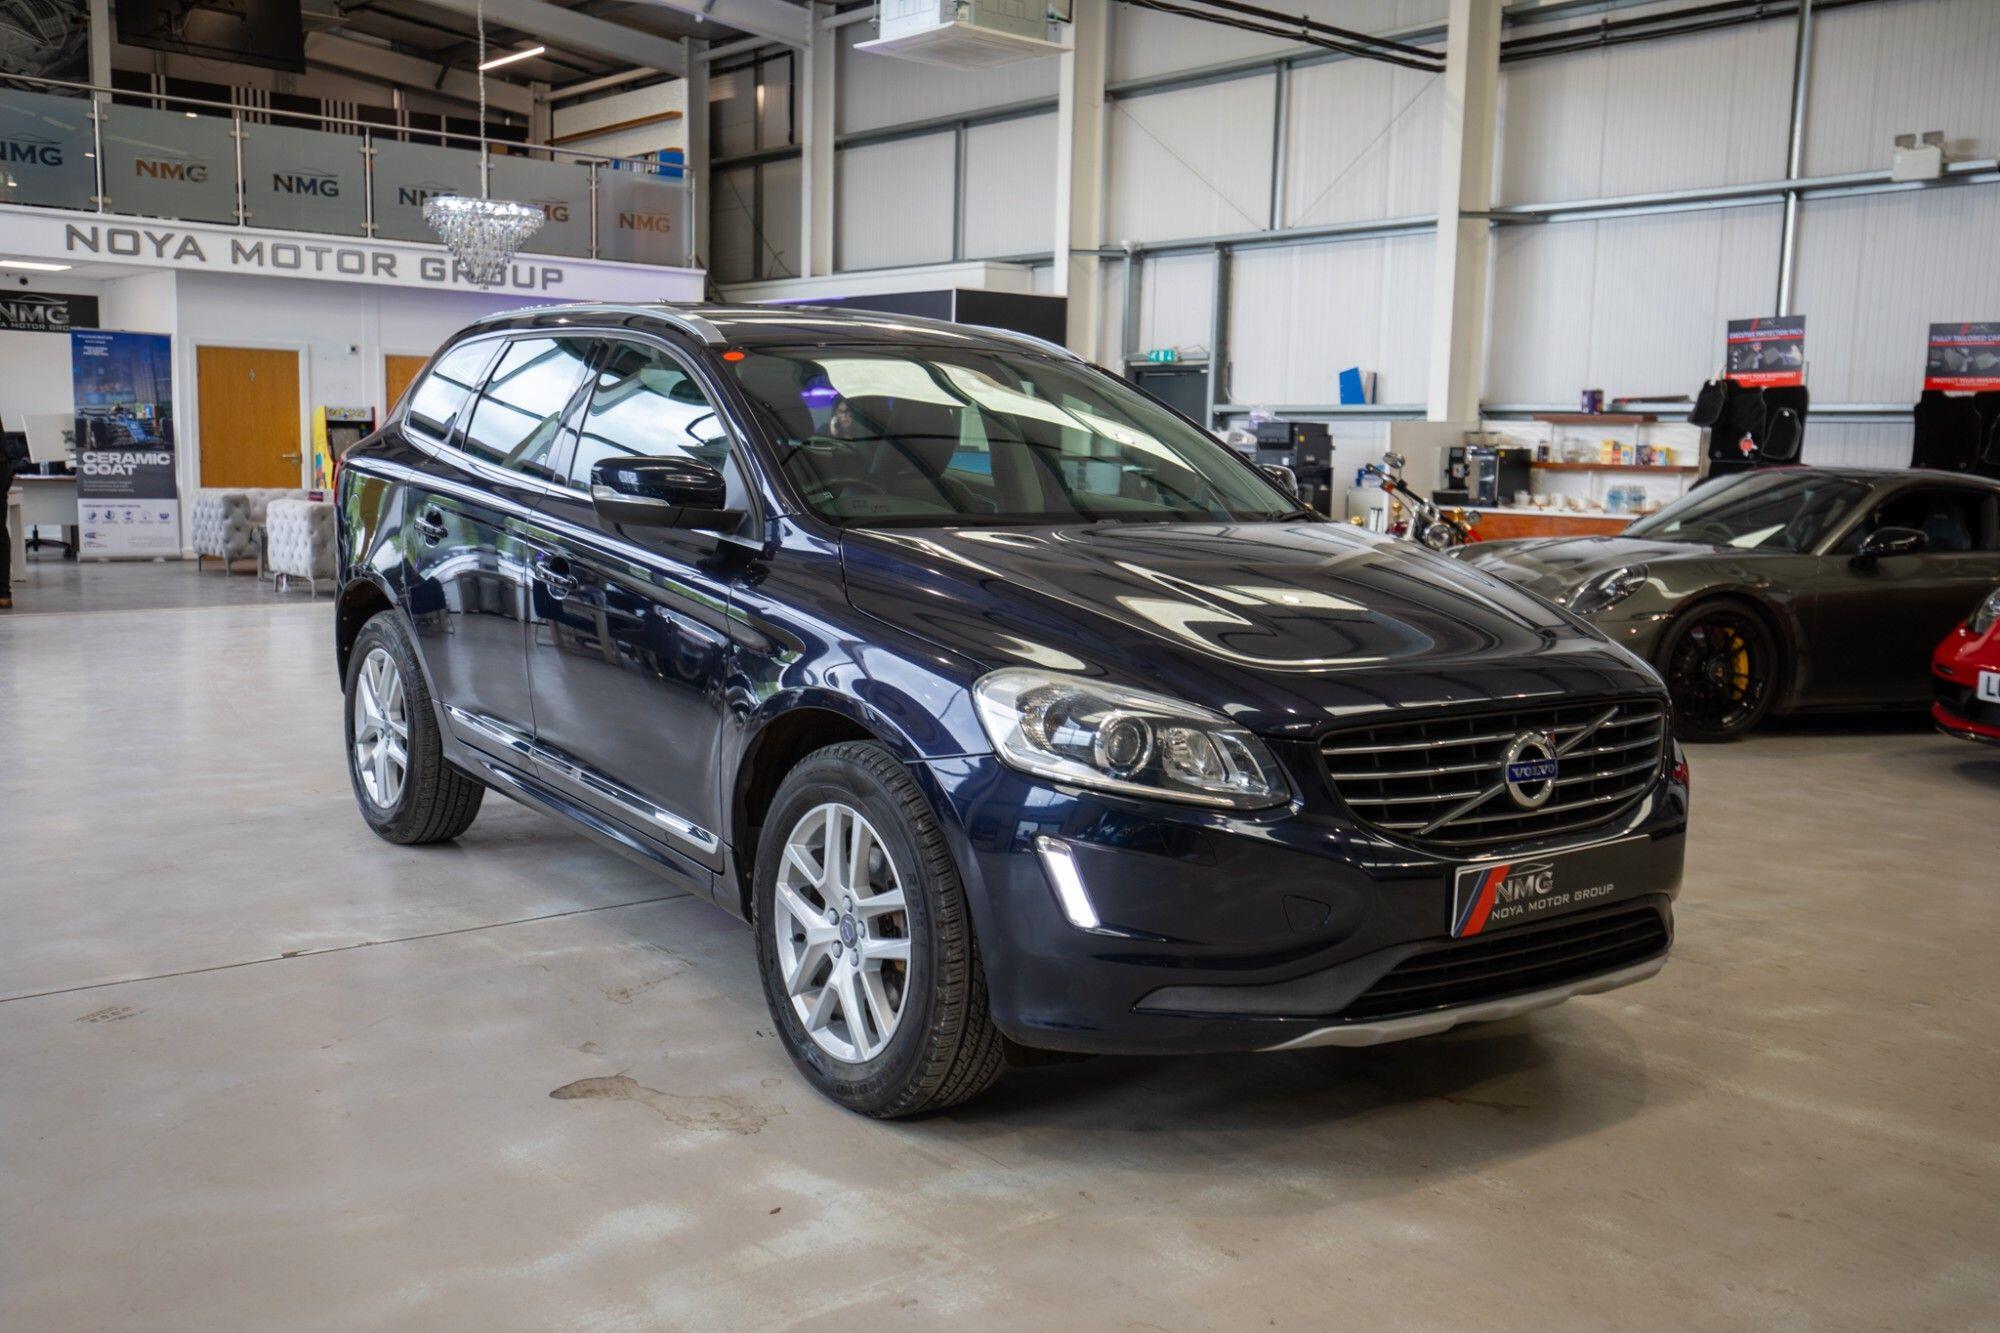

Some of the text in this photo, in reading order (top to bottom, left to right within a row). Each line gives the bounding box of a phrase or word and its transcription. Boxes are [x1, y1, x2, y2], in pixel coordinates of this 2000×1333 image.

[135, 158, 208, 182] NMG
[273, 173, 339, 198] NMG
[619, 212, 671, 233] NMG
[65, 224, 207, 262] NOYA
[231, 239, 398, 278] MOTOR
[11, 322, 46, 330] MOTOR
[82, 451, 171, 466] CERAMIC
[82, 463, 137, 476] COAT
[1986, 676, 2000, 697] L
[1511, 764, 1556, 778] VOLVO
[1495, 871, 1554, 905] NMG
[1491, 883, 1614, 920] NOYA MOTOR GROUP
